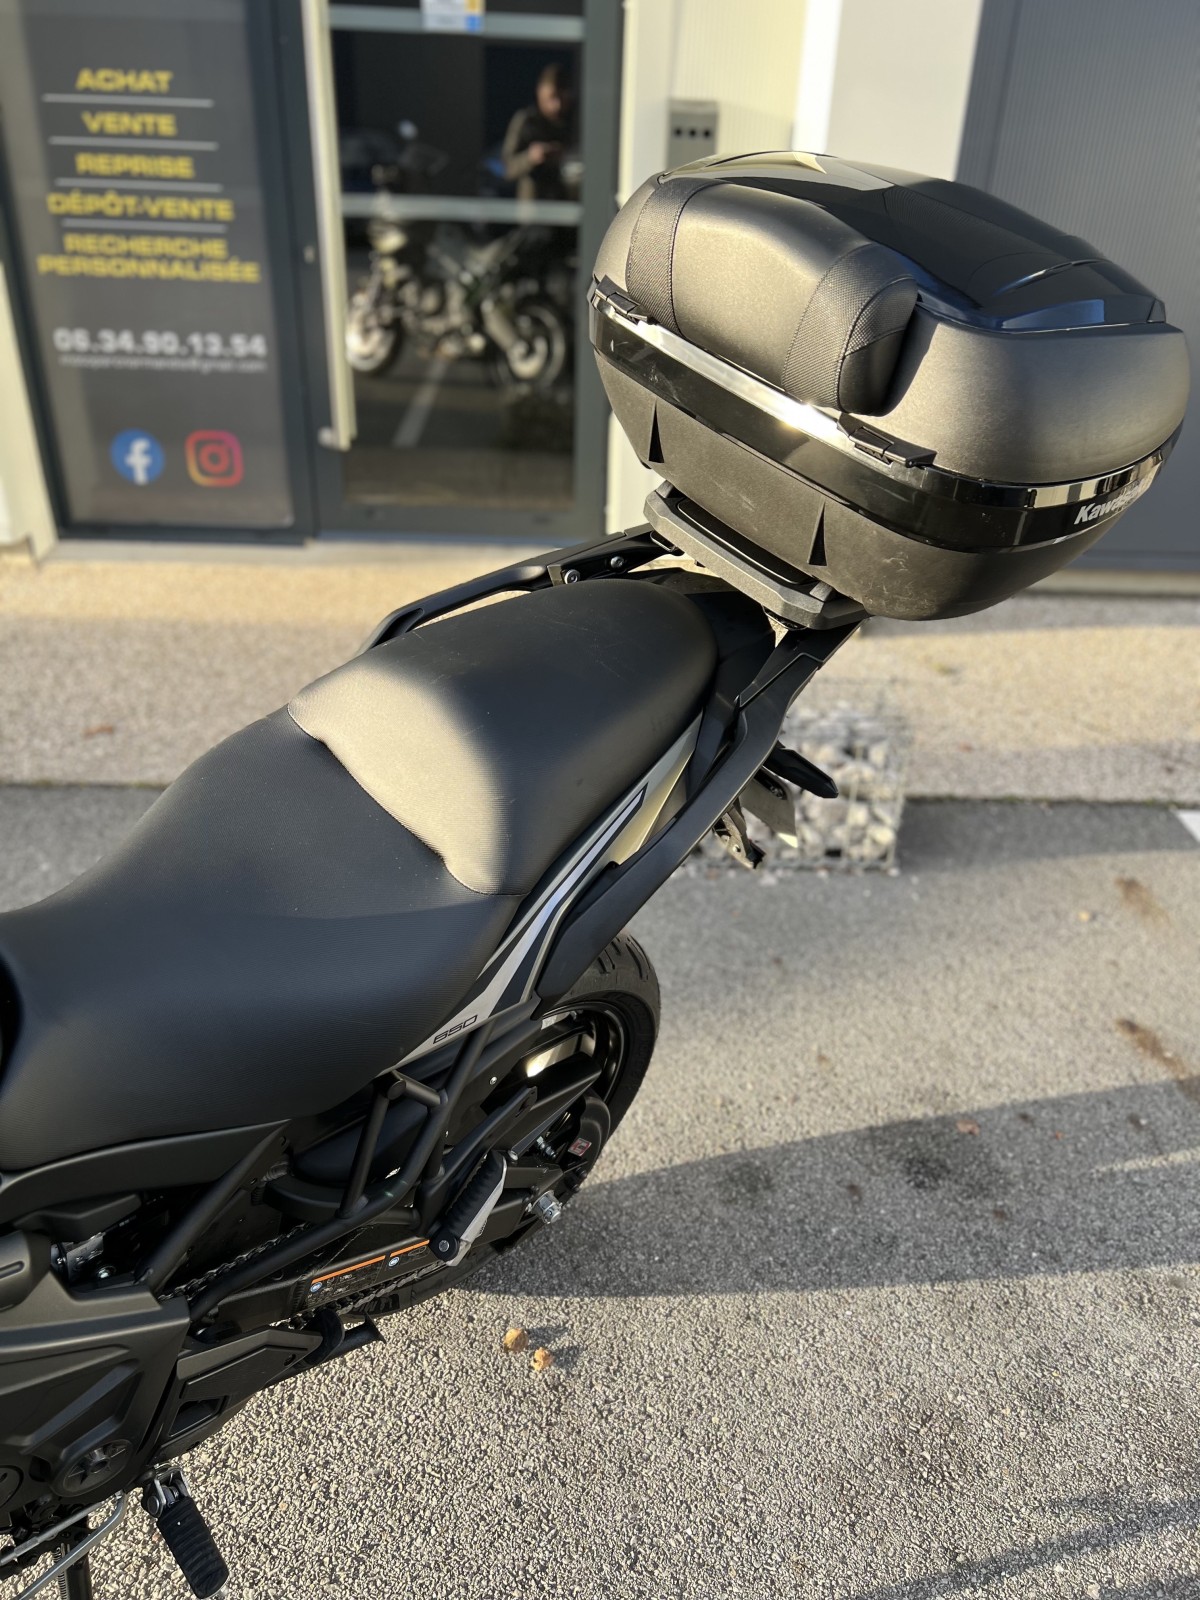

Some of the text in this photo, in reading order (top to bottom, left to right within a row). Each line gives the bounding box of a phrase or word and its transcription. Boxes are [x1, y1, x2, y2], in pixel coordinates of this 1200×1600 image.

[76, 68, 173, 93] ACHAT
[82, 111, 177, 136] VENTE
[75, 153, 194, 178] REPRISE
[47, 188, 234, 221] DÉPÔT-VENTE
[63, 233, 228, 260] RECHERCHE
[36, 255, 260, 283] PERSONNALISÉE
[432, 1014, 478, 1045] 650
